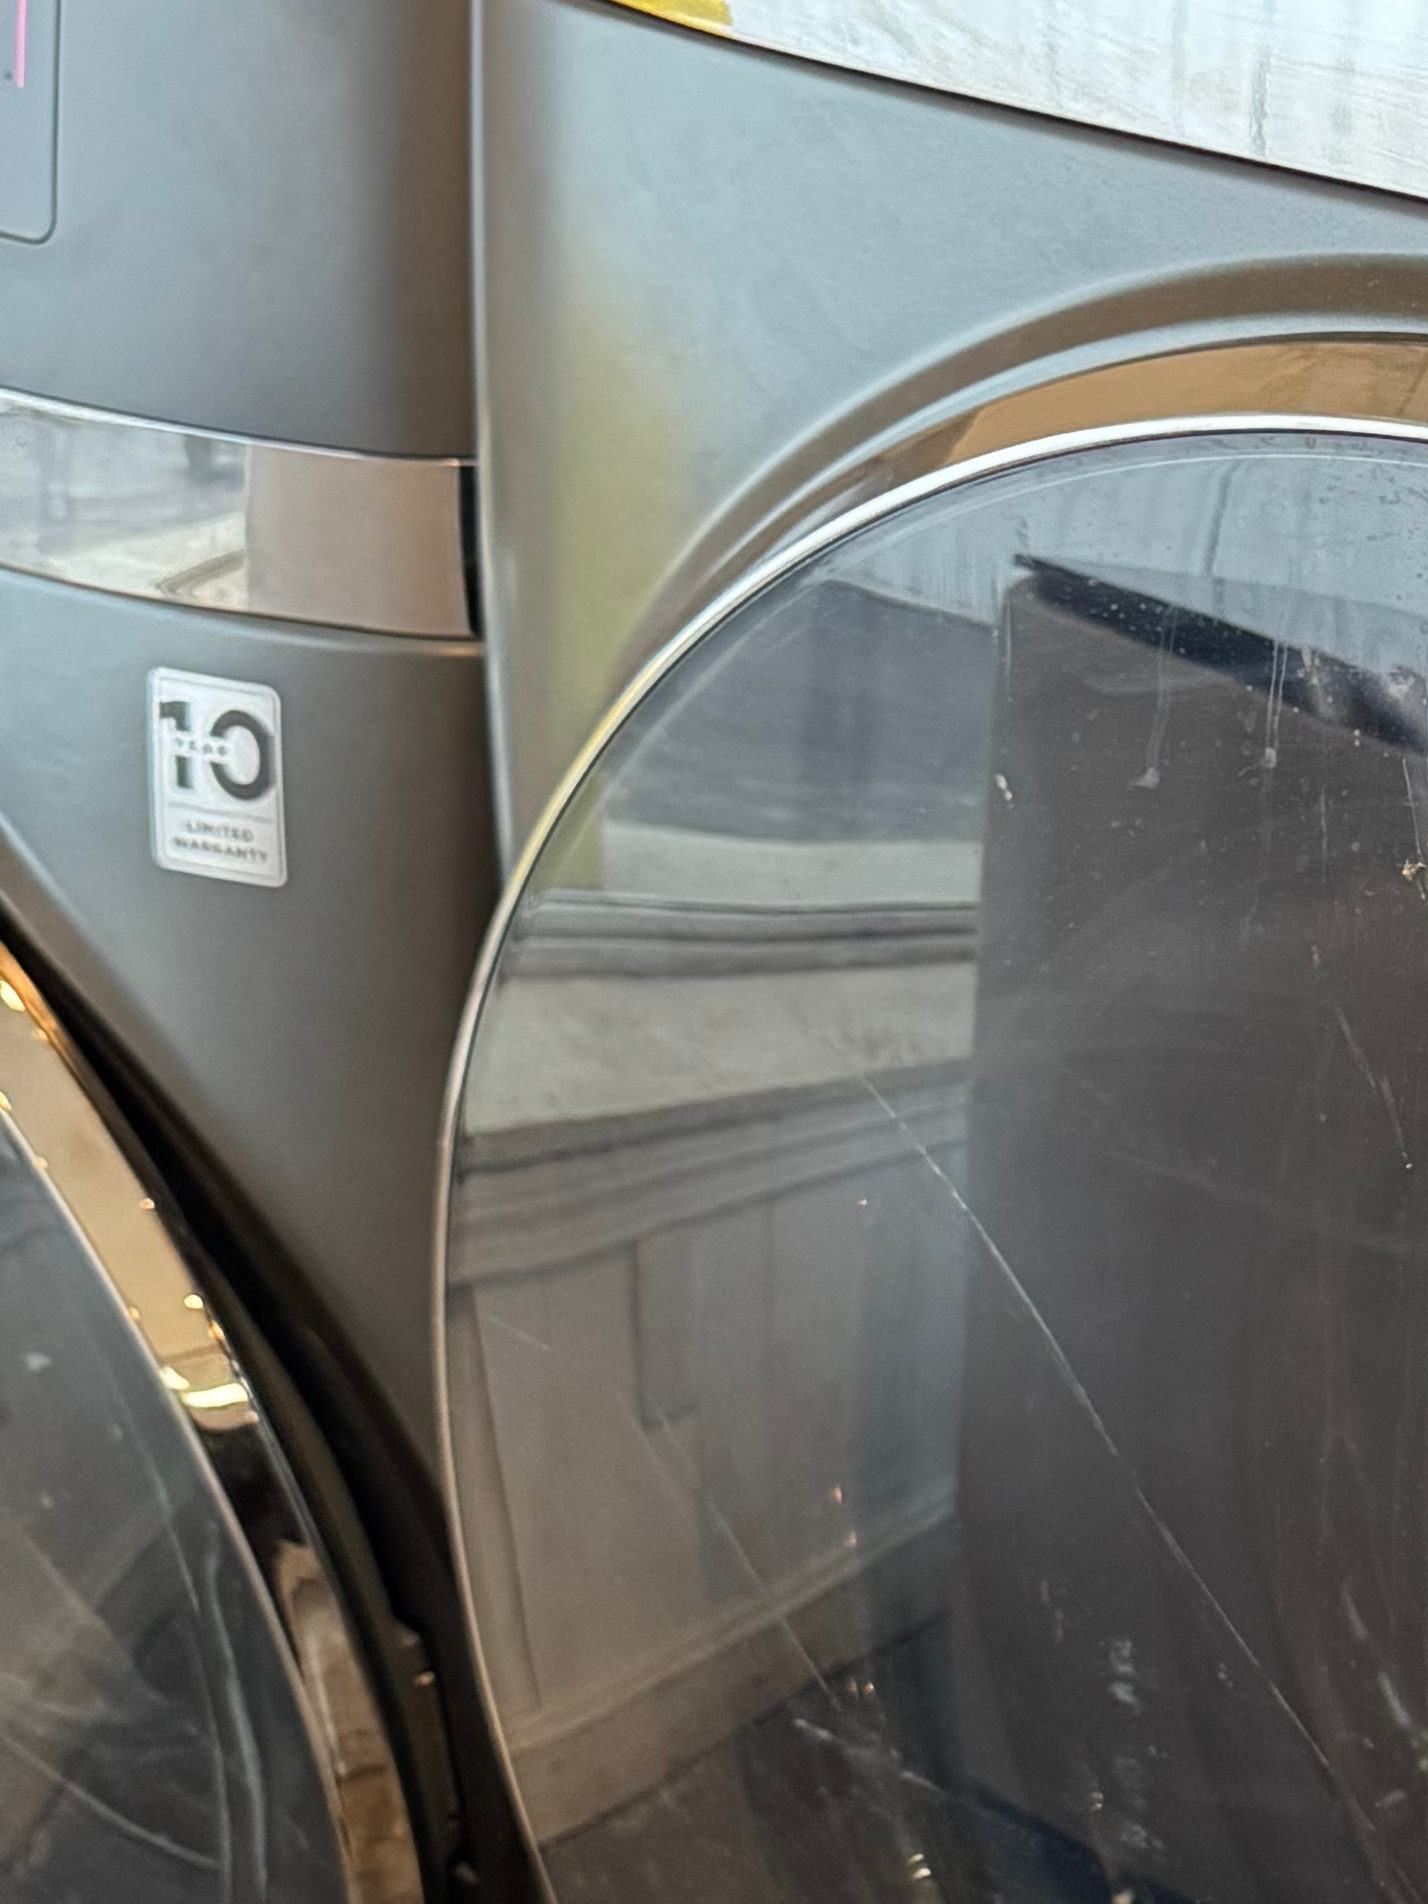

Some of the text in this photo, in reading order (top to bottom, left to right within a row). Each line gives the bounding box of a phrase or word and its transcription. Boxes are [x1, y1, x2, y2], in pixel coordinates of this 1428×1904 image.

[160, 700, 276, 801] 10
[186, 821, 254, 843] LIMITED
[174, 836, 269, 863] WARRANTY
